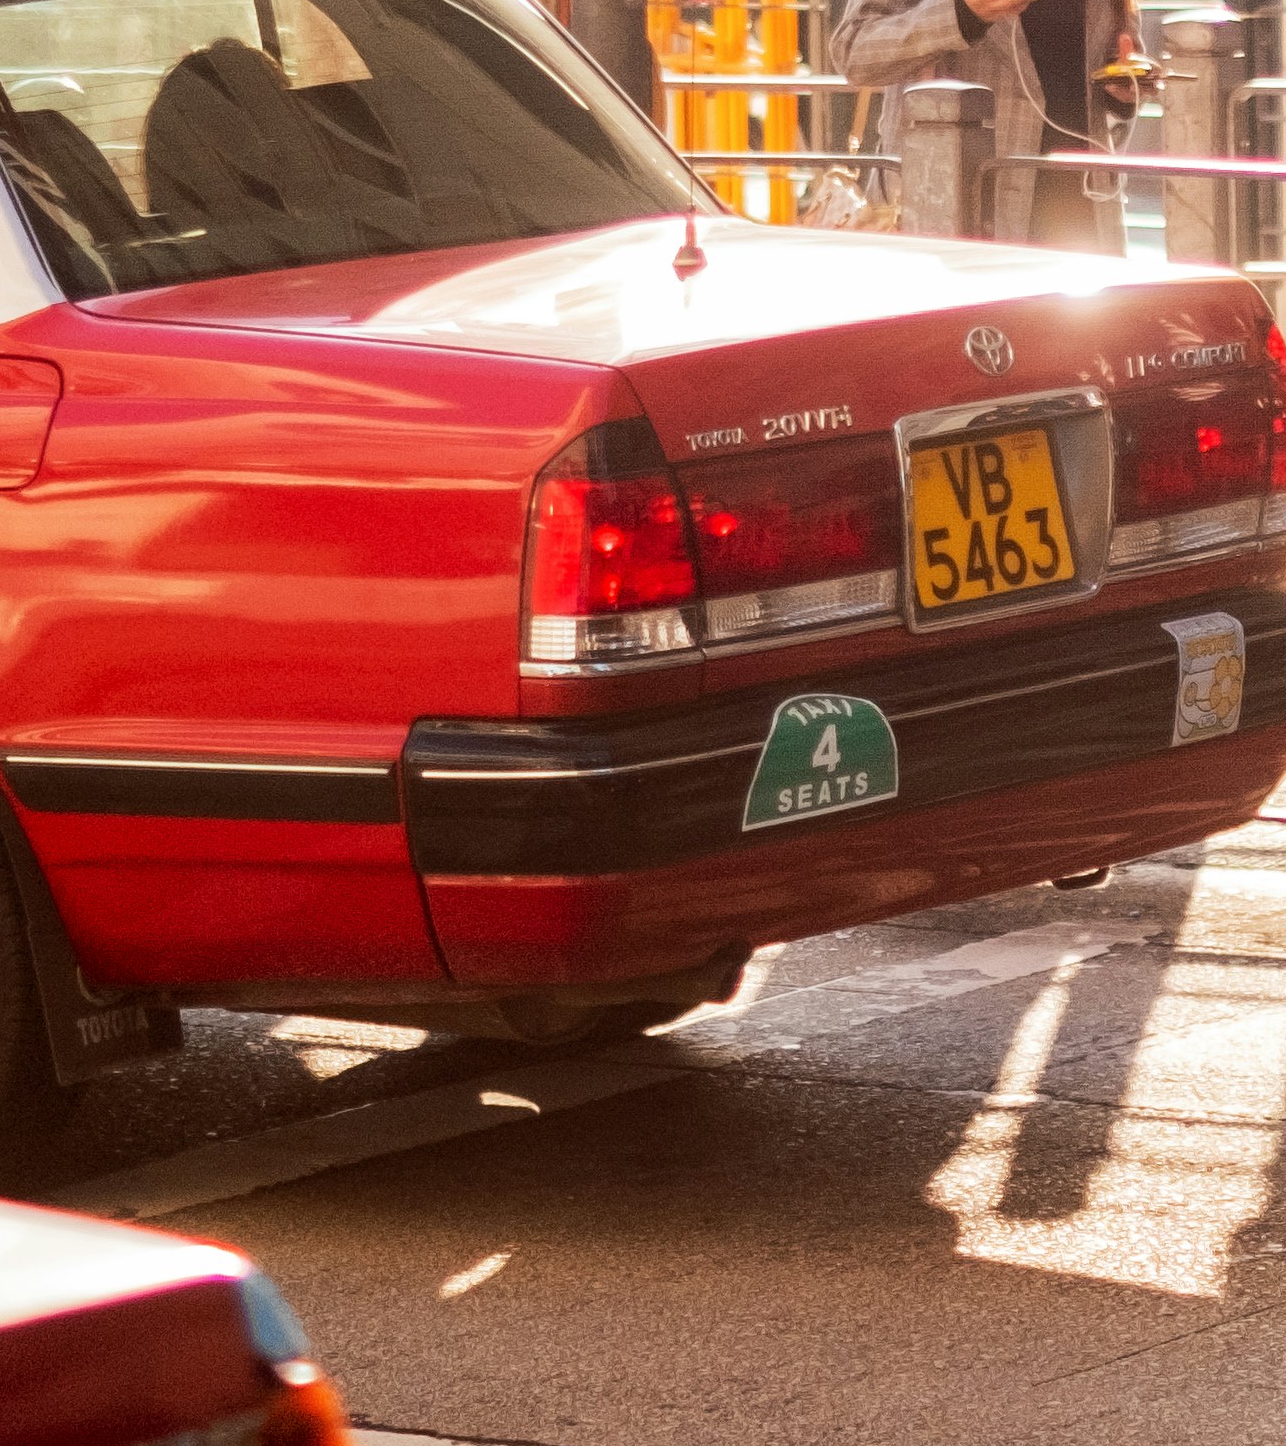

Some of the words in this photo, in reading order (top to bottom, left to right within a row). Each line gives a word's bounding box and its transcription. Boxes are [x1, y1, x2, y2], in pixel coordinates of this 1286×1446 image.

[685, 427, 750, 451] TOYOTA
[940, 442, 1013, 521] VB
[923, 507, 1061, 601] 5463
[787, 698, 853, 727] TAXI
[812, 723, 842, 773] 4
[778, 771, 869, 814] SEATS
